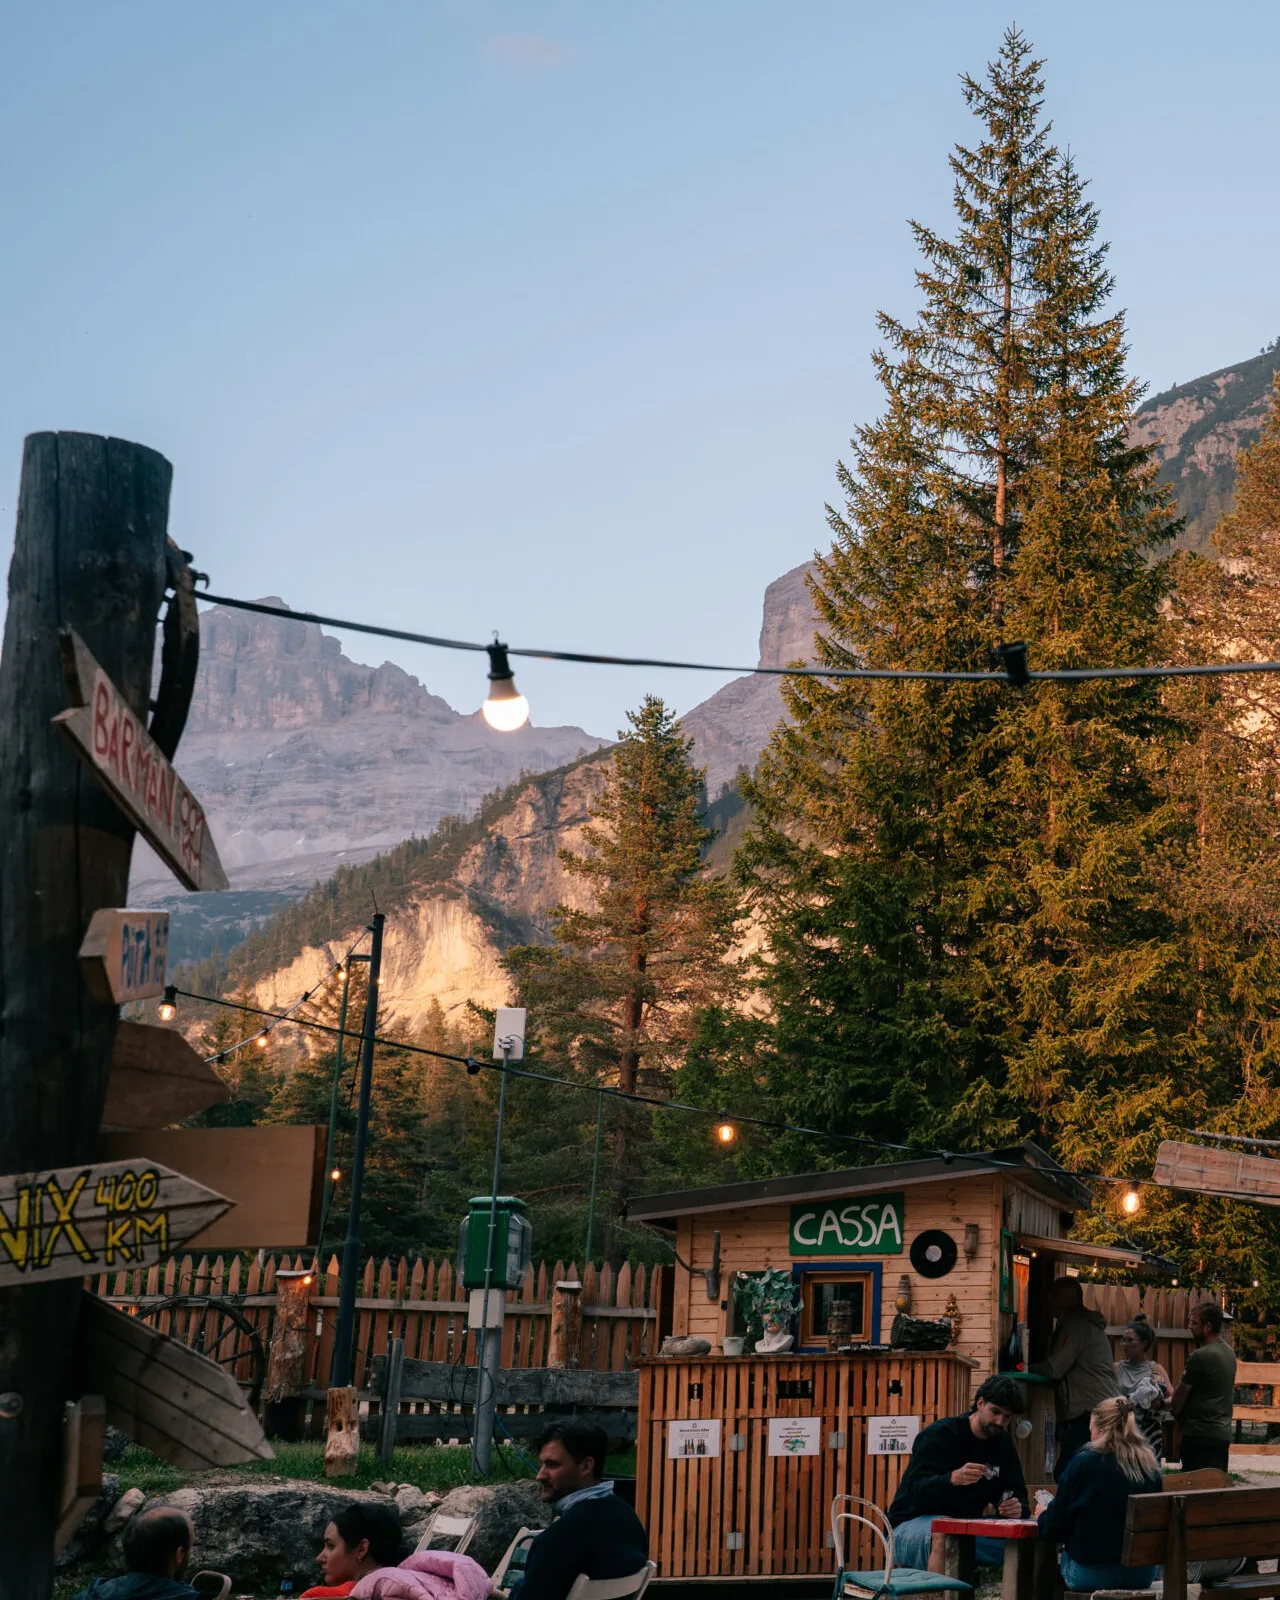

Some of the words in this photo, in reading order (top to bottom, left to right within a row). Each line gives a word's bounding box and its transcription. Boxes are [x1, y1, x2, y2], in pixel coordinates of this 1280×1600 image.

[94, 681, 177, 836] BARMAN
[95, 1169, 161, 1214] 400
[104, 1211, 170, 1266] KM
[793, 1204, 902, 1247] CASSA
